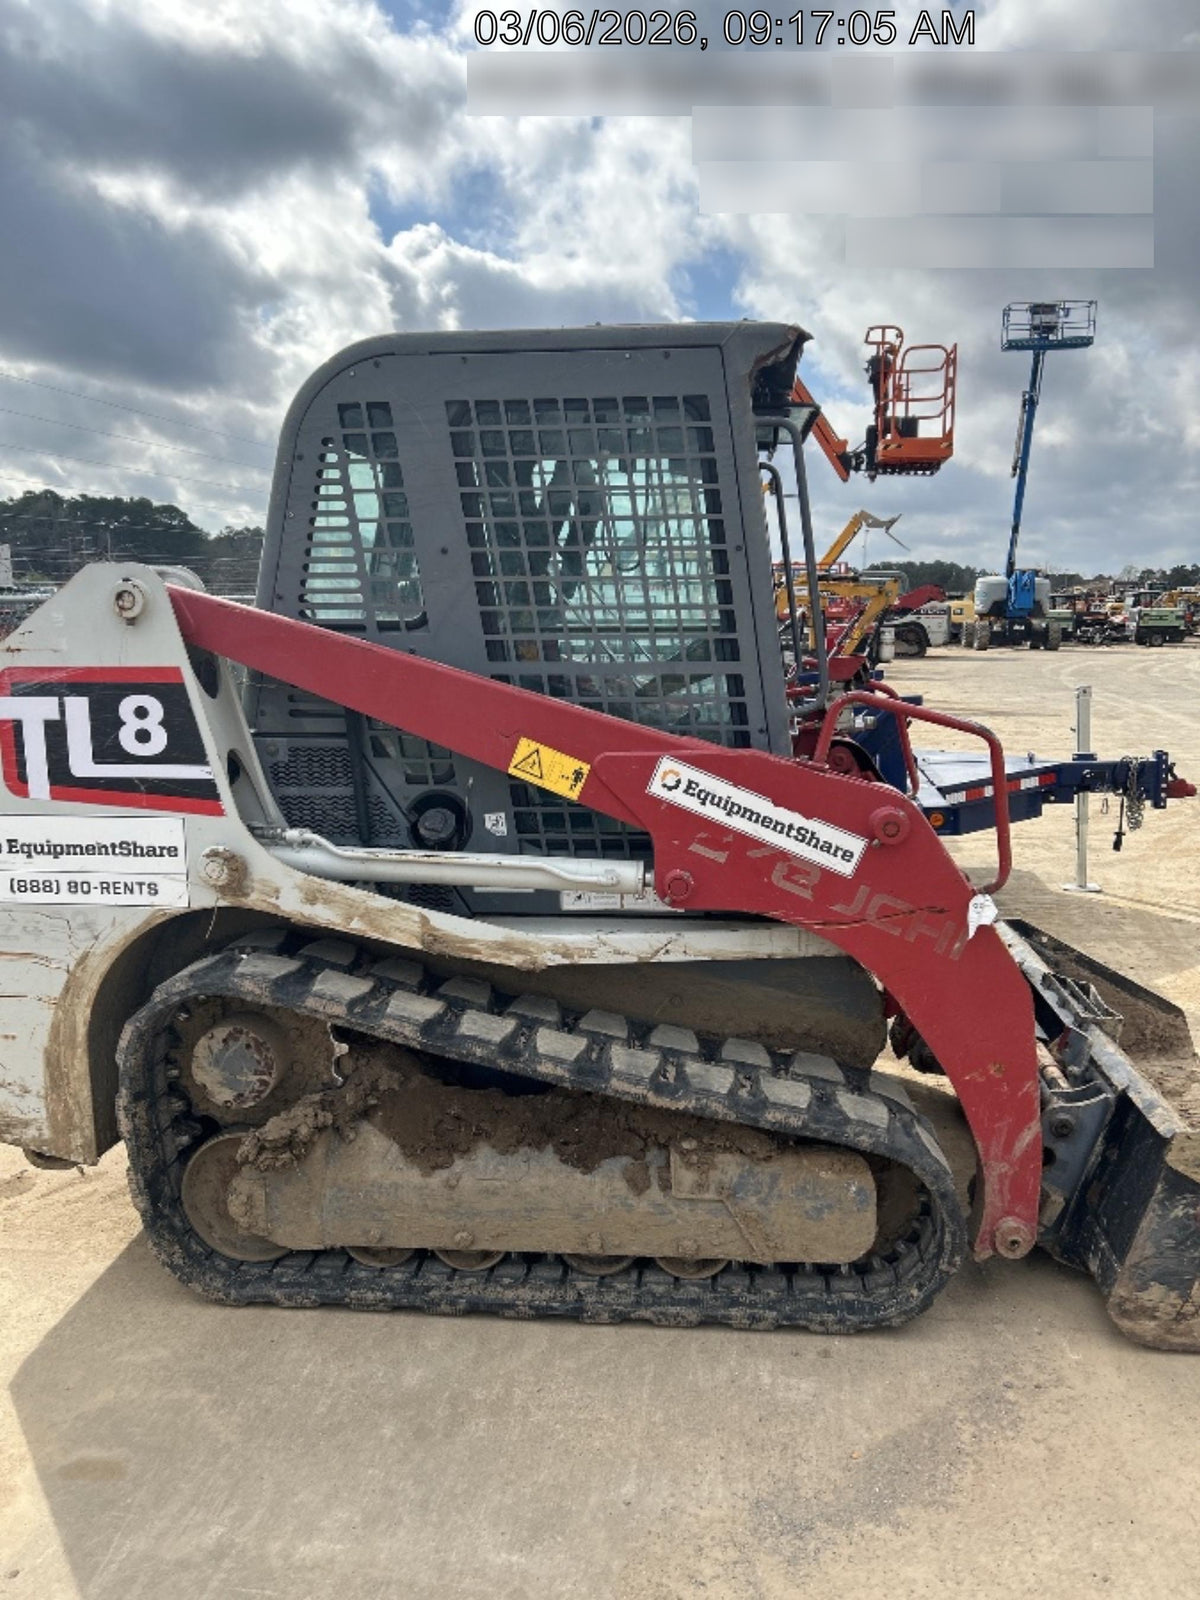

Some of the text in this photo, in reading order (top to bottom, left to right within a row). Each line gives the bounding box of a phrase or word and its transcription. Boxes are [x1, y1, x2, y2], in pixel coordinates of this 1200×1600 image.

[682, 777, 855, 864] EquipmentShare
[6, 838, 179, 859] EquipmentShare
[9, 877, 159, 897] (888) 80-RENTS
